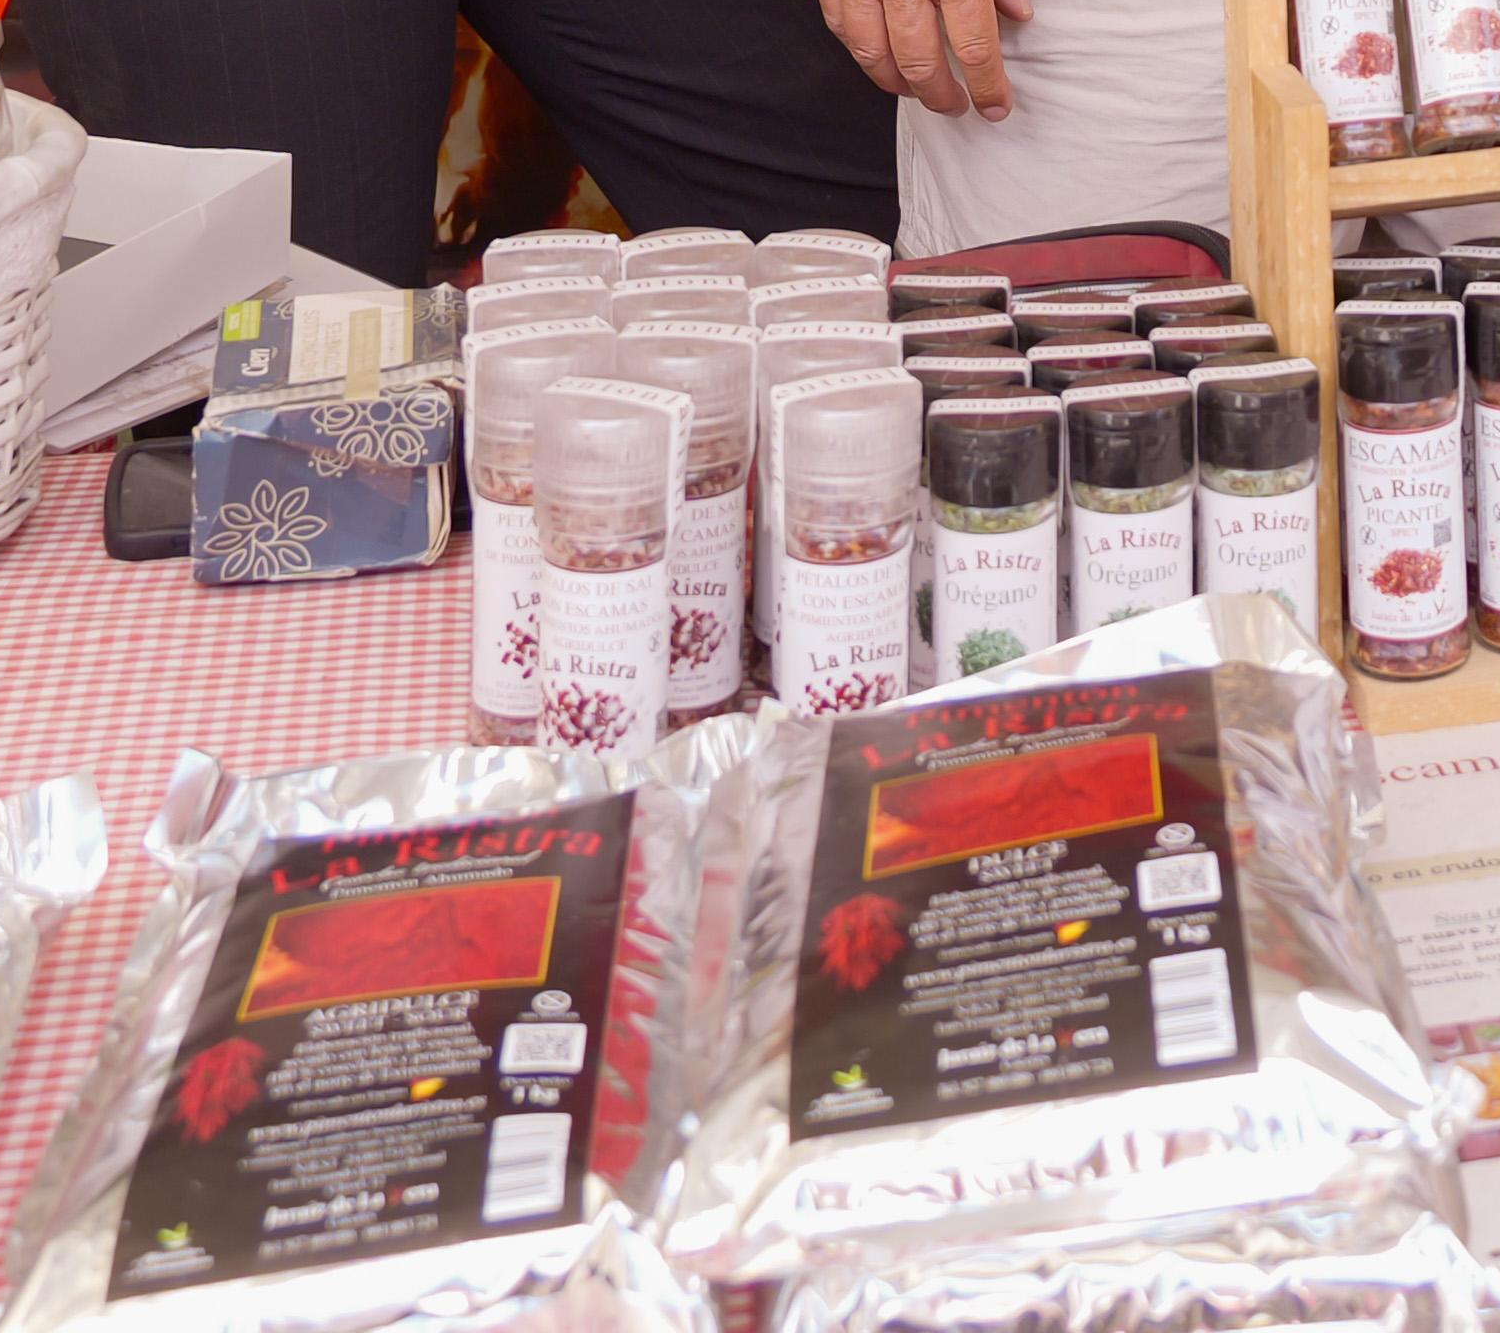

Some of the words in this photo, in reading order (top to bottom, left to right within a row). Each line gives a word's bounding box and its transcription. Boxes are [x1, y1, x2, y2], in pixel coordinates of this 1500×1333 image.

[1349, 437, 1456, 465] ESCAMAS
[1357, 484, 1383, 503] La
[1392, 479, 1451, 499] Ristra
[1367, 504, 1443, 524] PICANTE
[1084, 535, 1109, 555] La
[1121, 530, 1180, 550] Ristra
[943, 553, 966, 574] La
[977, 549, 1041, 572] Ristra
[1087, 560, 1178, 590] Orégano
[946, 581, 1037, 611] Orégano
[569, 654, 636, 679] Ristra
[1393, 866, 1420, 880] en
